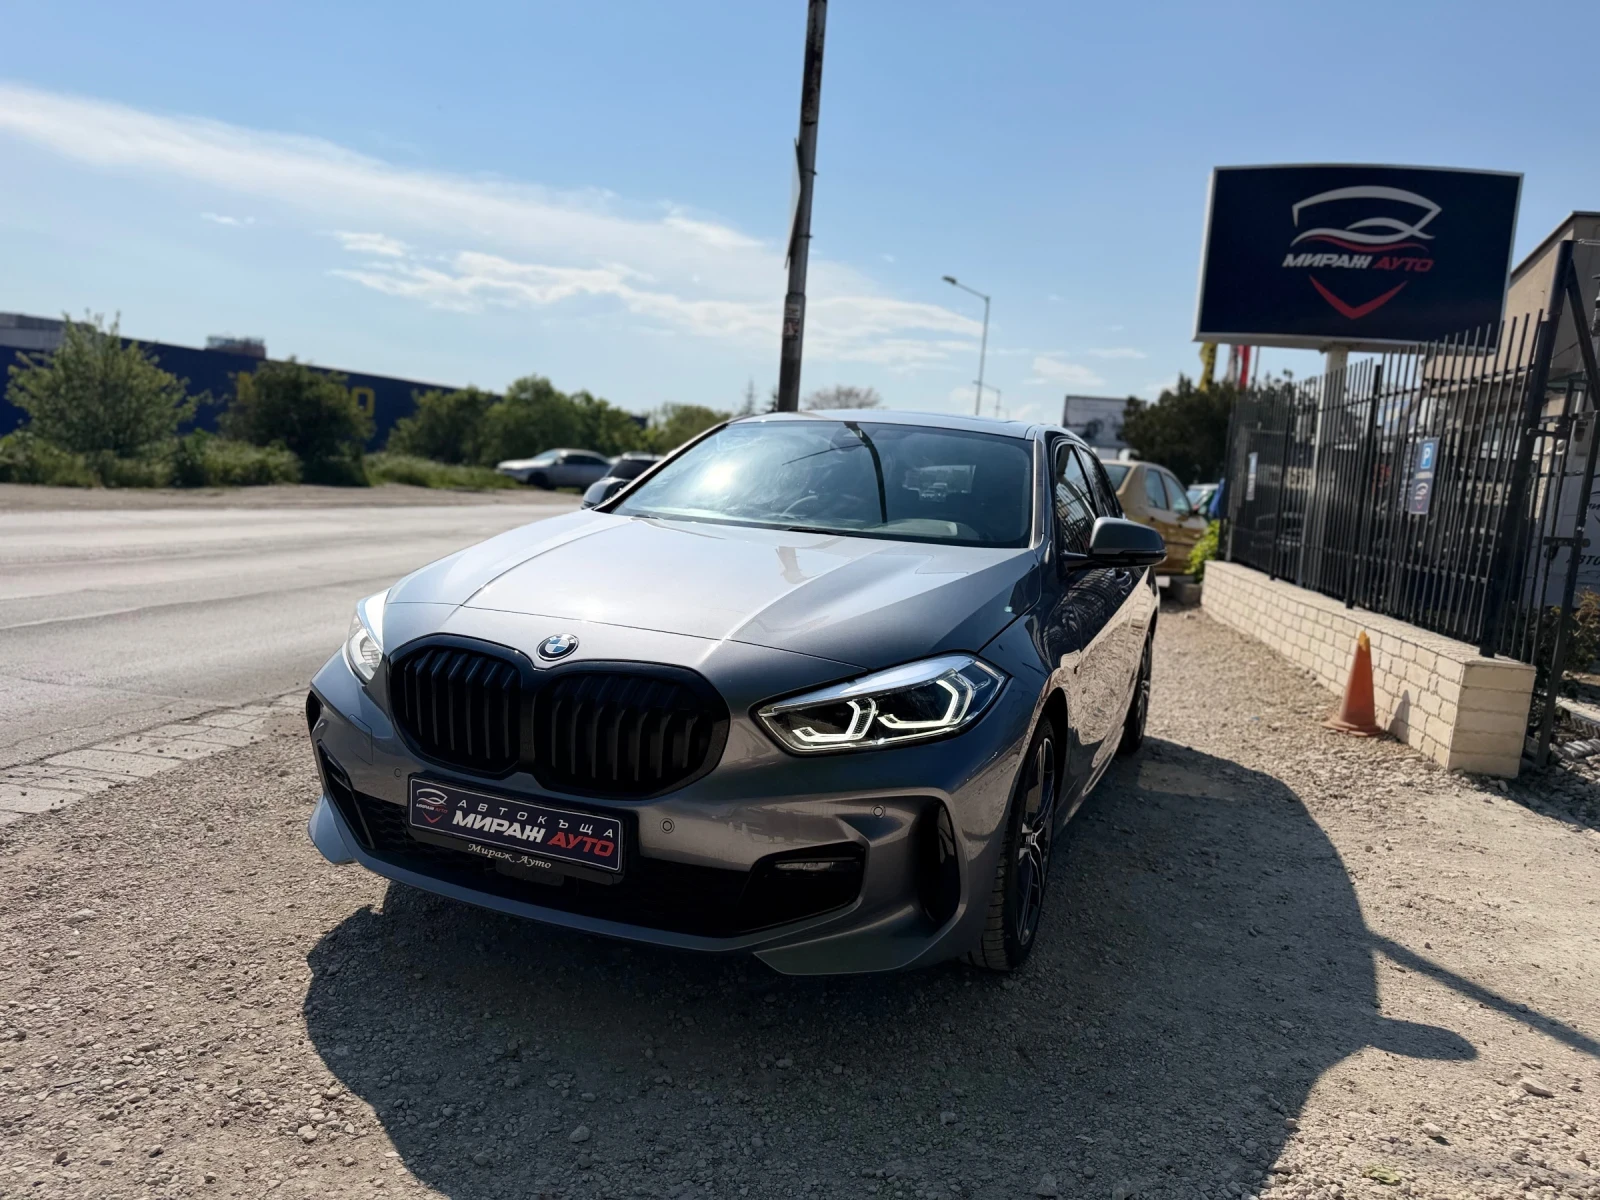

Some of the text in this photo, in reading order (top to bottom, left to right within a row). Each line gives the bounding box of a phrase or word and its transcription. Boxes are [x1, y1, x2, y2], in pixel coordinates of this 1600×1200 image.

[1282, 253, 1434, 272] МИРАЖ АУТО
[452, 810, 615, 857] МИРАЖ АУТО
[468, 843, 552, 869] Мираж Ауто
